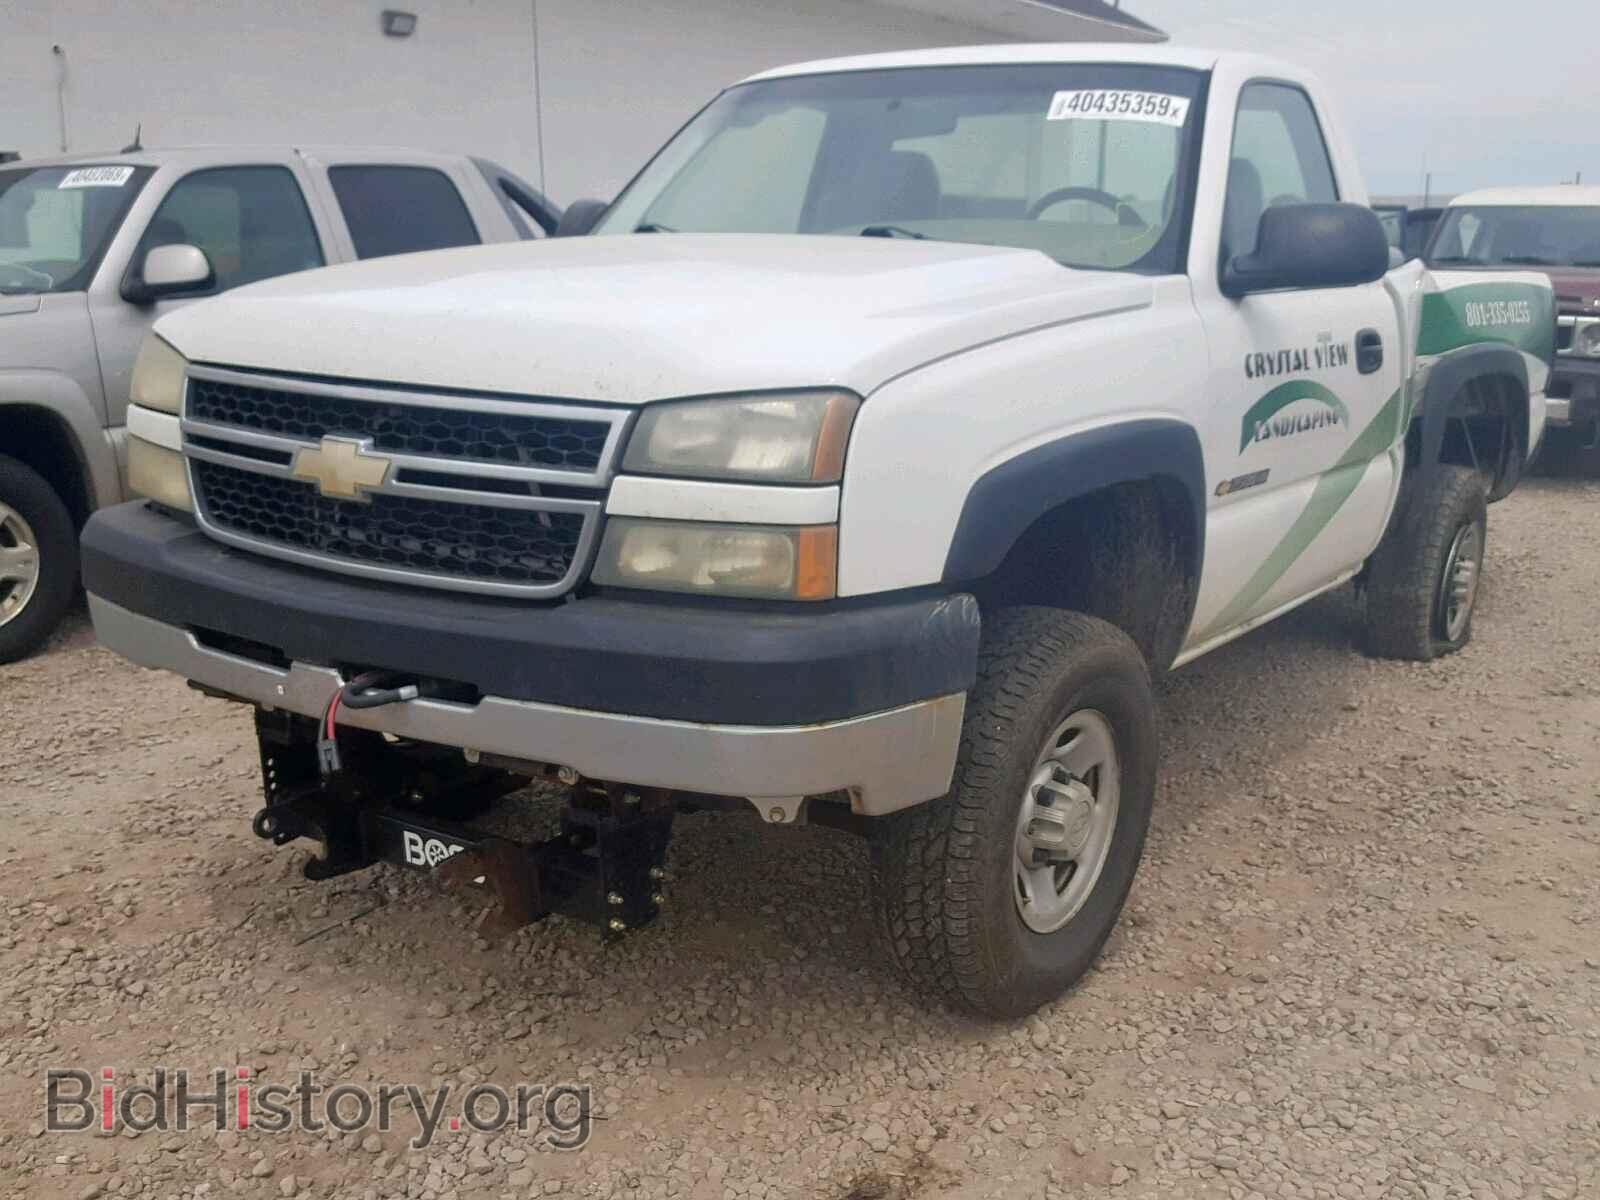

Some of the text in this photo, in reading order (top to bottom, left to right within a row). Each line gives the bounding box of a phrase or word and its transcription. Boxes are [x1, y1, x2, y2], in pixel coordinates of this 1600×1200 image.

[1067, 92, 1171, 116] 40435359
[1465, 302, 1530, 327] 801-335-0255
[1245, 343, 1348, 378] CRYSTAL VIEW
[1254, 408, 1339, 442] LANDSCAPING
